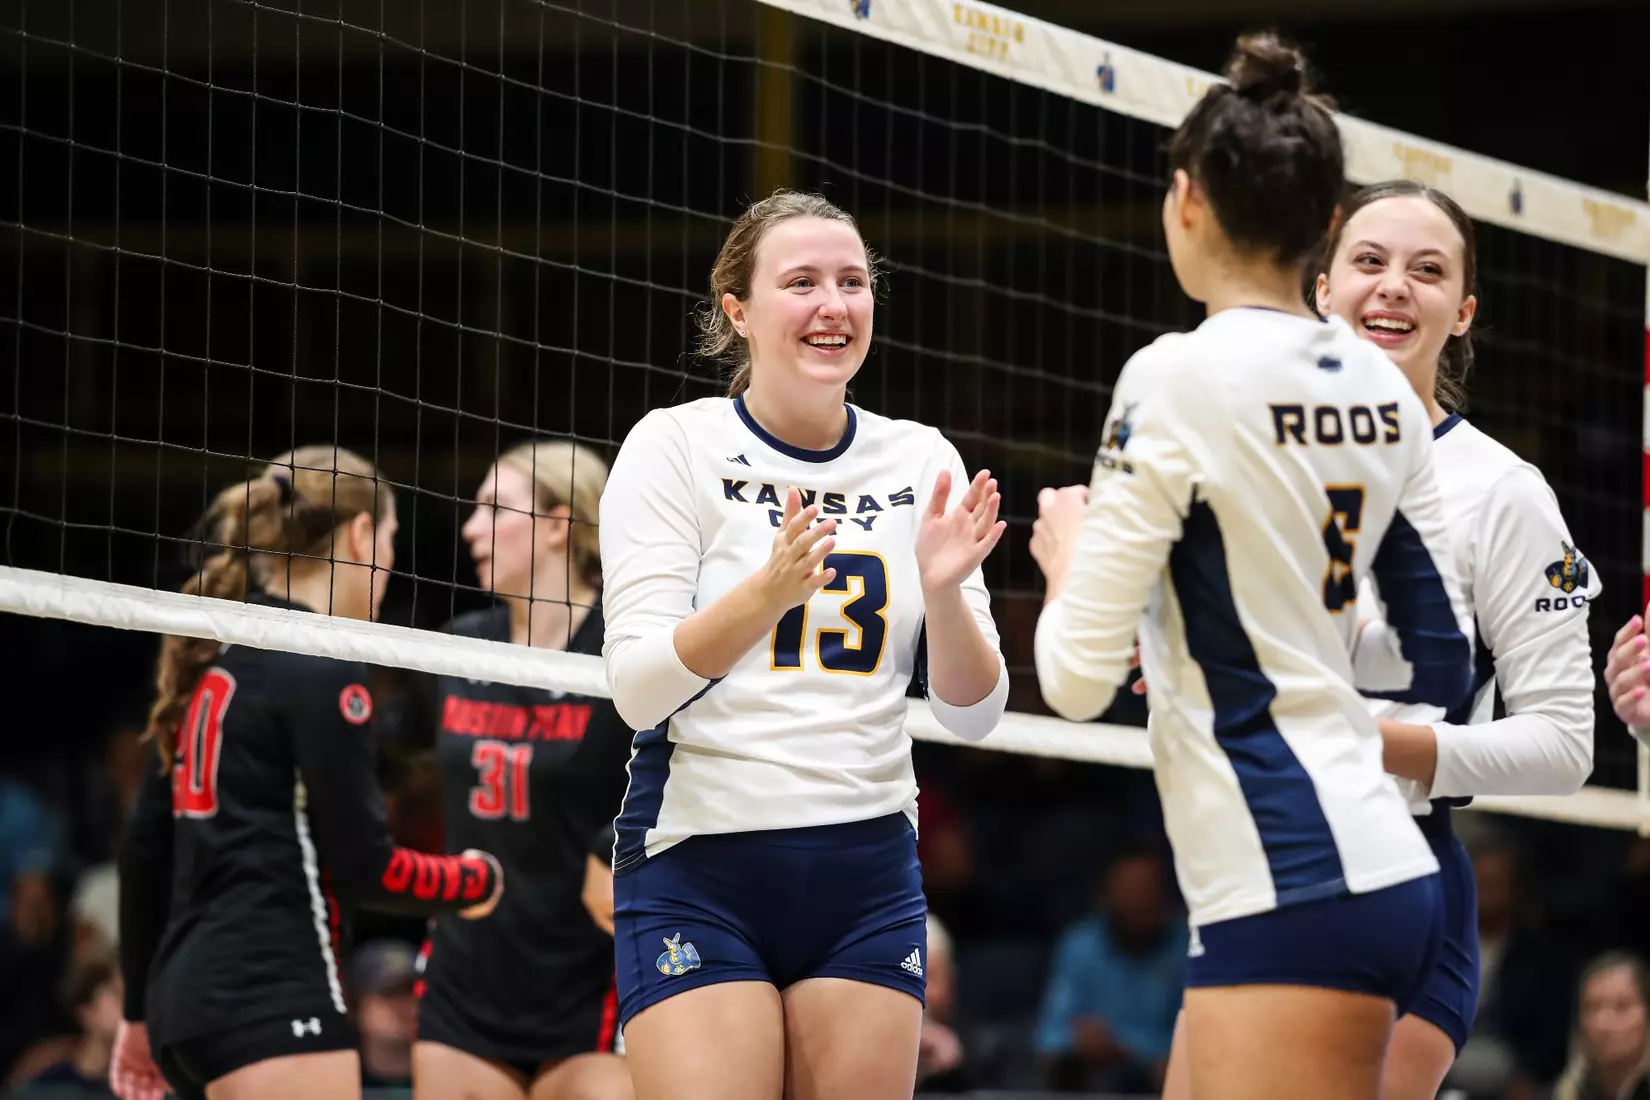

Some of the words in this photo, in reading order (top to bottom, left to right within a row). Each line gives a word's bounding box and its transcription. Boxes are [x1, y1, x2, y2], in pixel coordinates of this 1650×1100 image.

[1268, 401, 1401, 446] ROOS
[768, 508, 878, 536] CTY
[1535, 595, 1592, 612] ROO
[469, 739, 534, 820] 31
